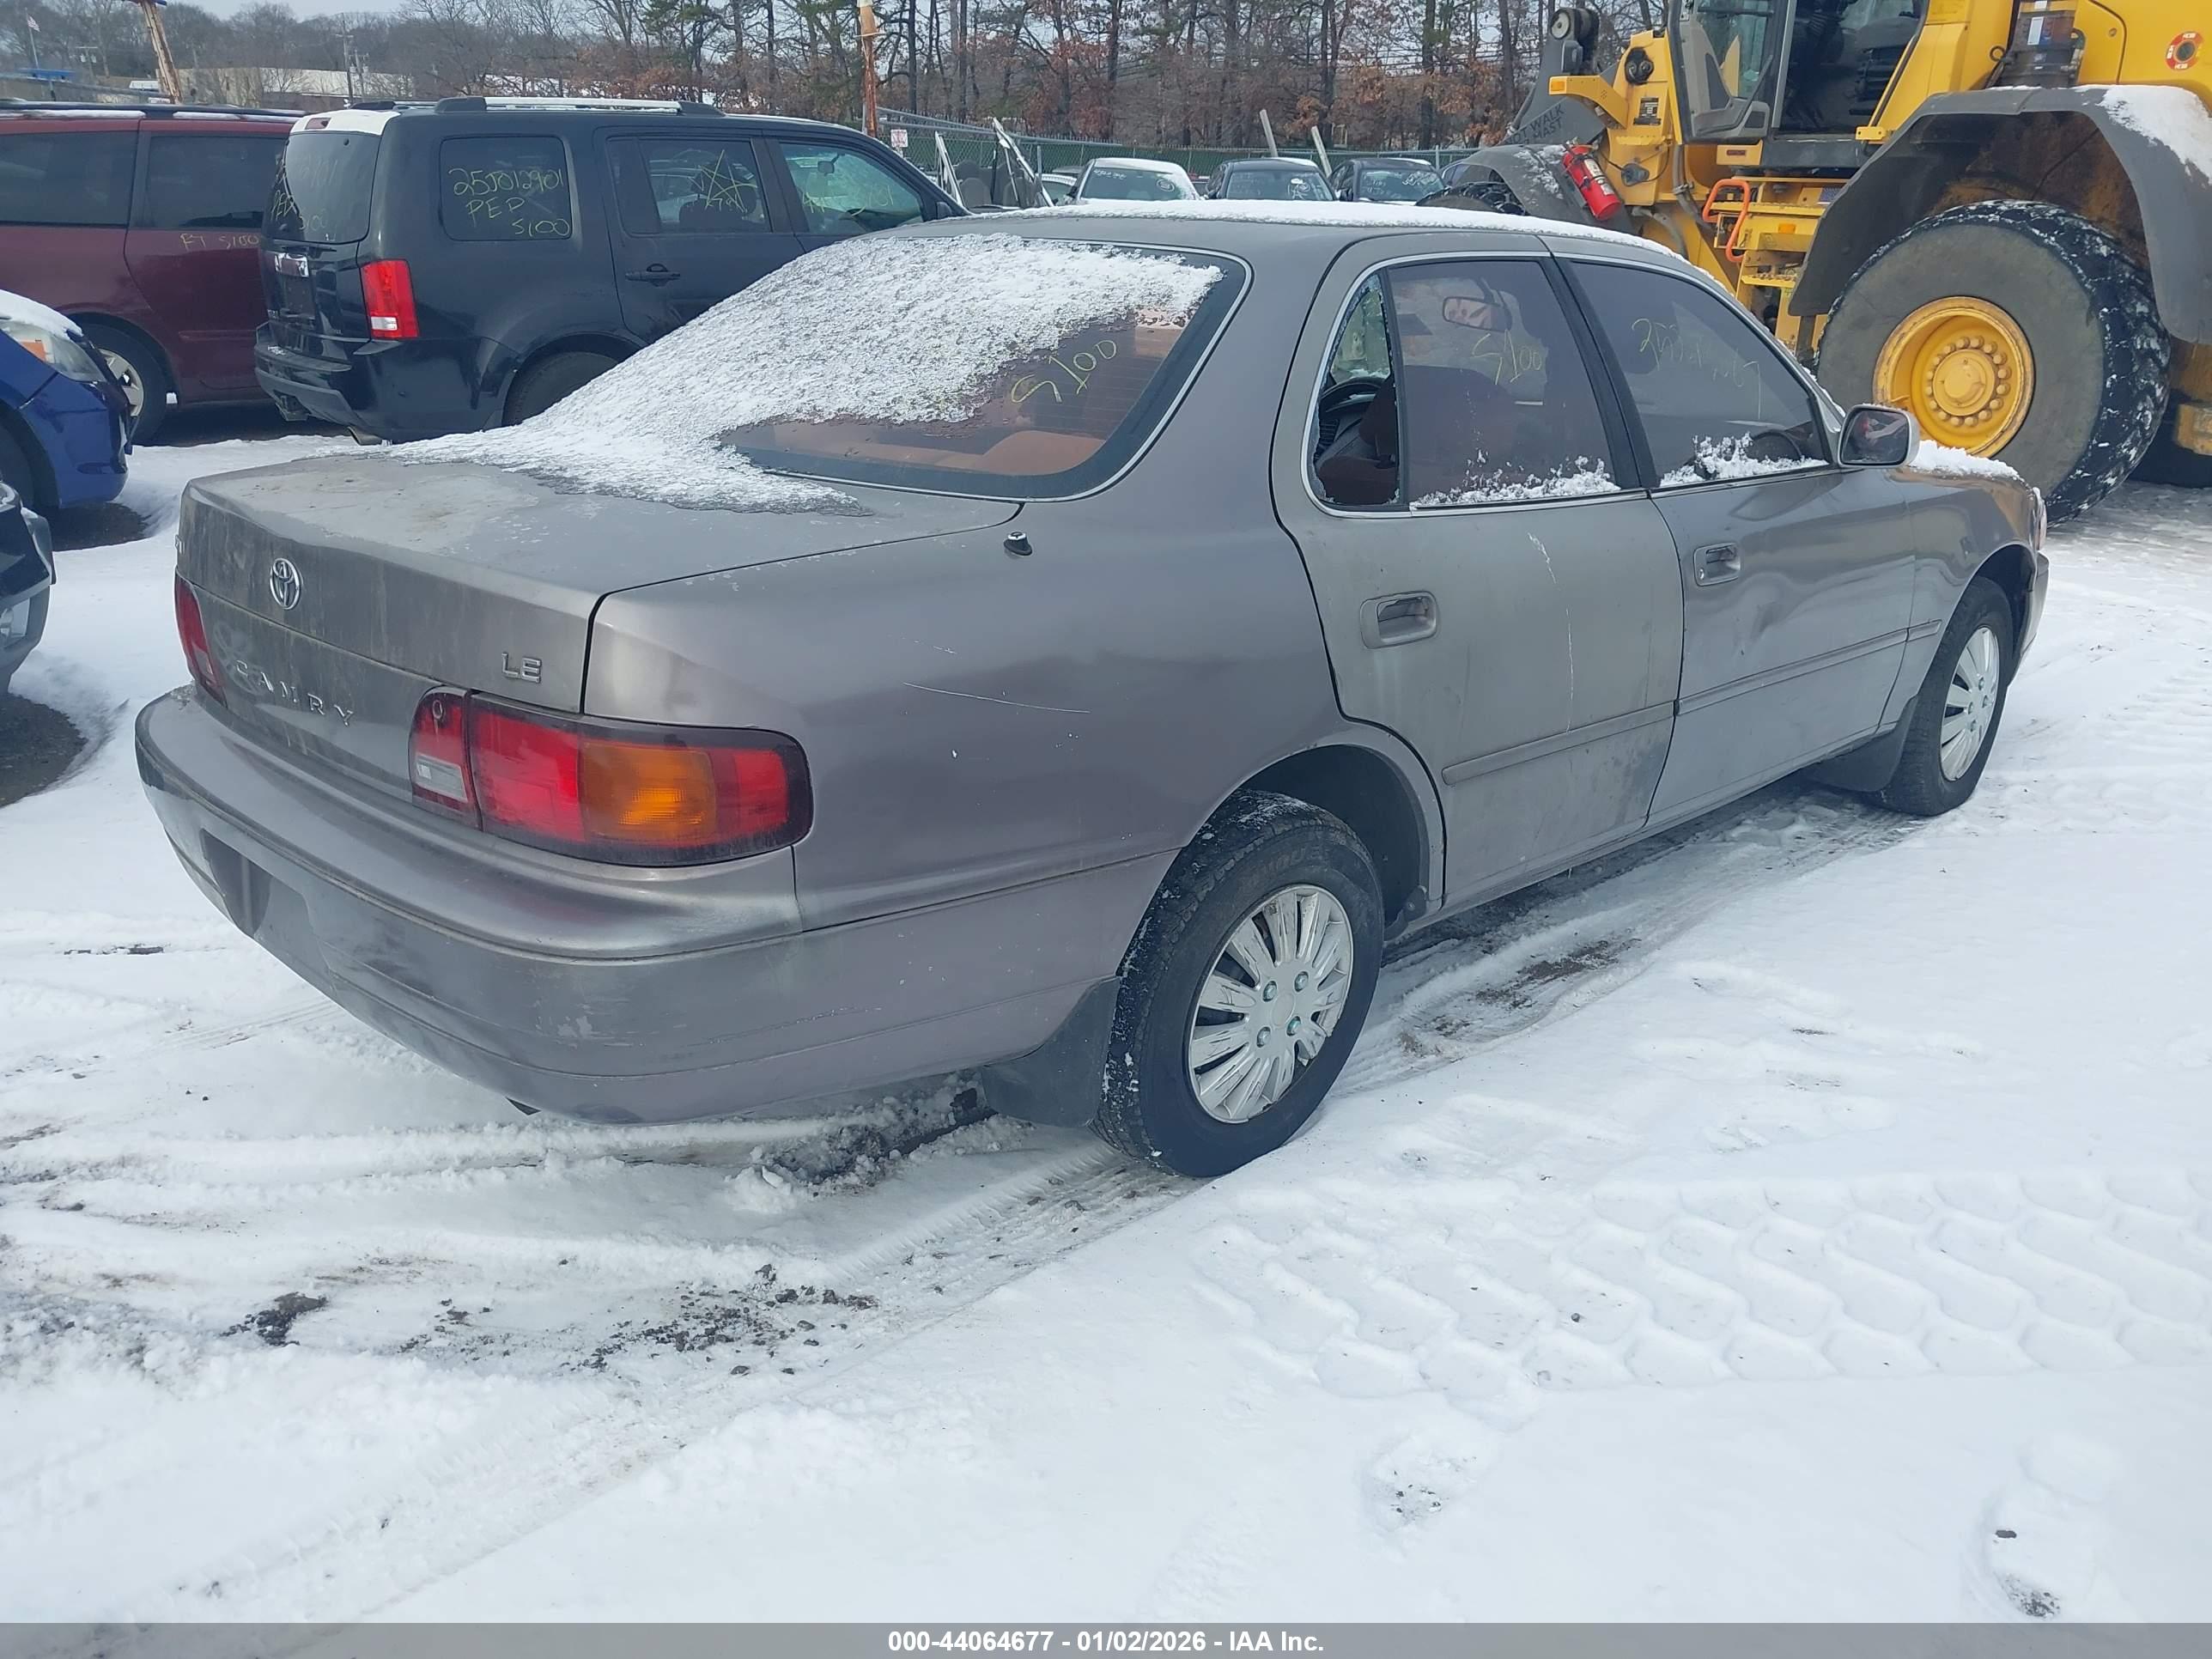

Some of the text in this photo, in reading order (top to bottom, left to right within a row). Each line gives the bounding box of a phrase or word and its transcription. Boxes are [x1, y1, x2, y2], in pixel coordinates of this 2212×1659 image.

[1529, 104, 1565, 131] WALK
[501, 652, 543, 684] LE
[235, 659, 355, 726] CAMRY
